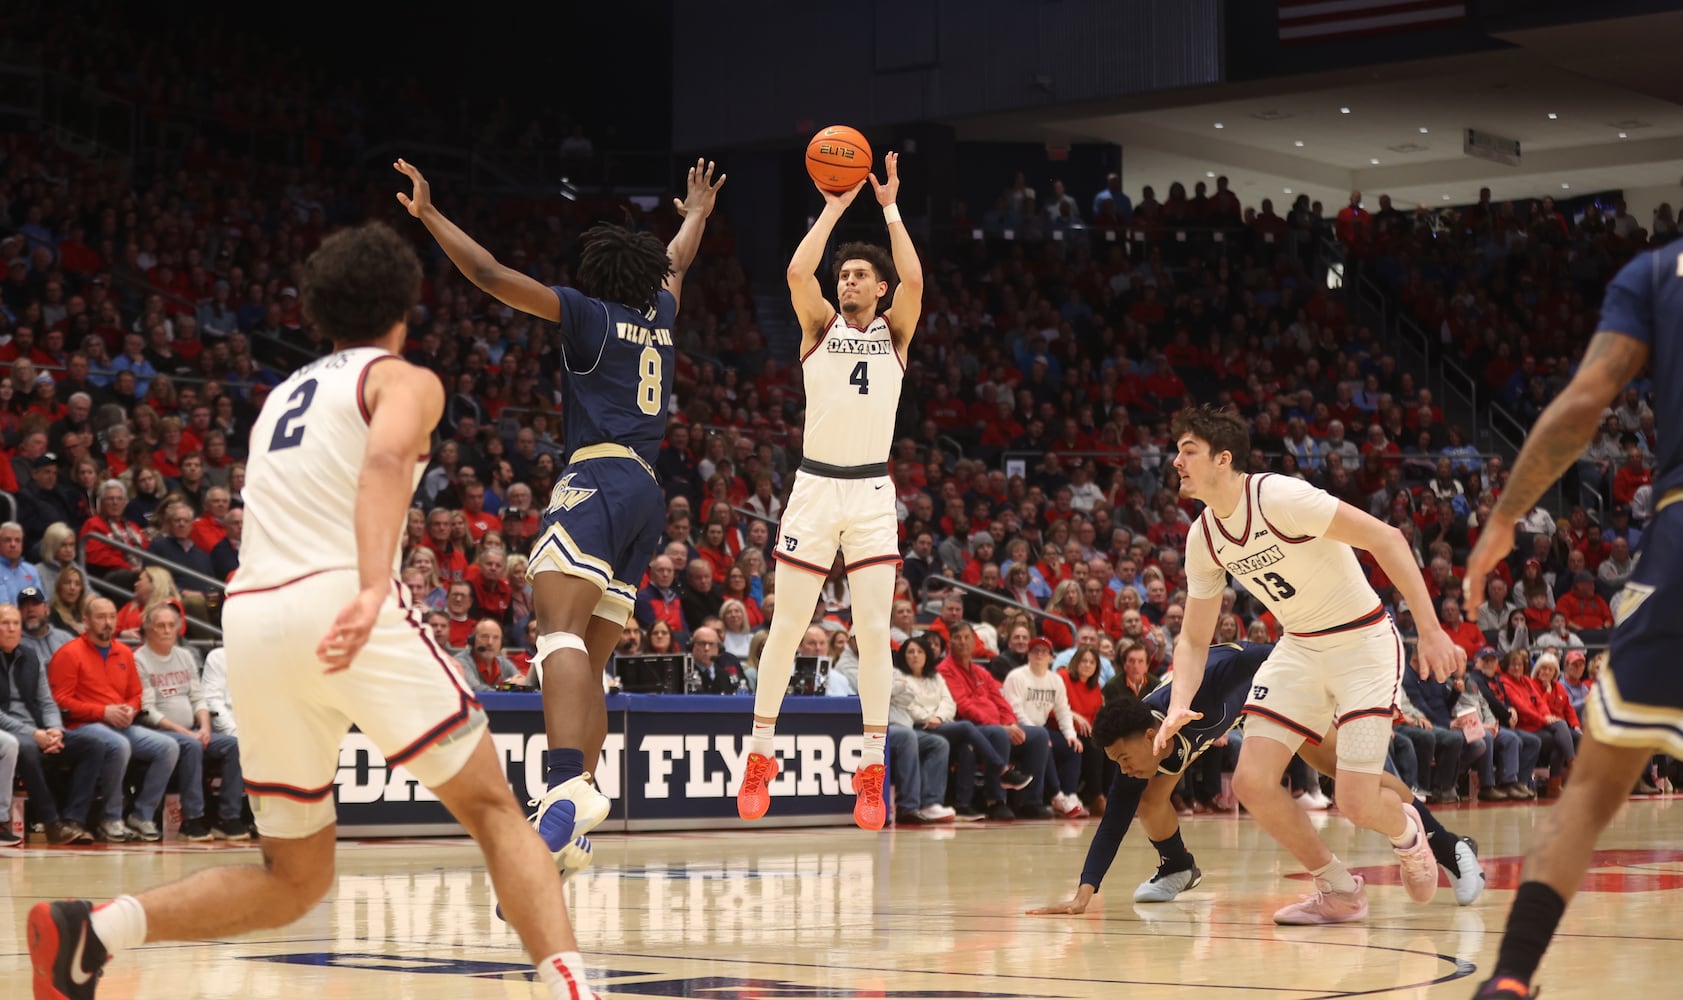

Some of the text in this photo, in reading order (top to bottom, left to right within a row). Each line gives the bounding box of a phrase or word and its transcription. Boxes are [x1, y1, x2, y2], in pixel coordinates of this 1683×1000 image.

[820, 144, 855, 160] ELITE
[827, 338, 890, 355] DAYTON
[637, 346, 662, 416] 8
[849, 361, 869, 395] 4
[268, 378, 318, 452] 2
[1226, 544, 1285, 575] DAYTON
[1252, 572, 1296, 602] 13
[639, 734, 866, 799] FLYERS
